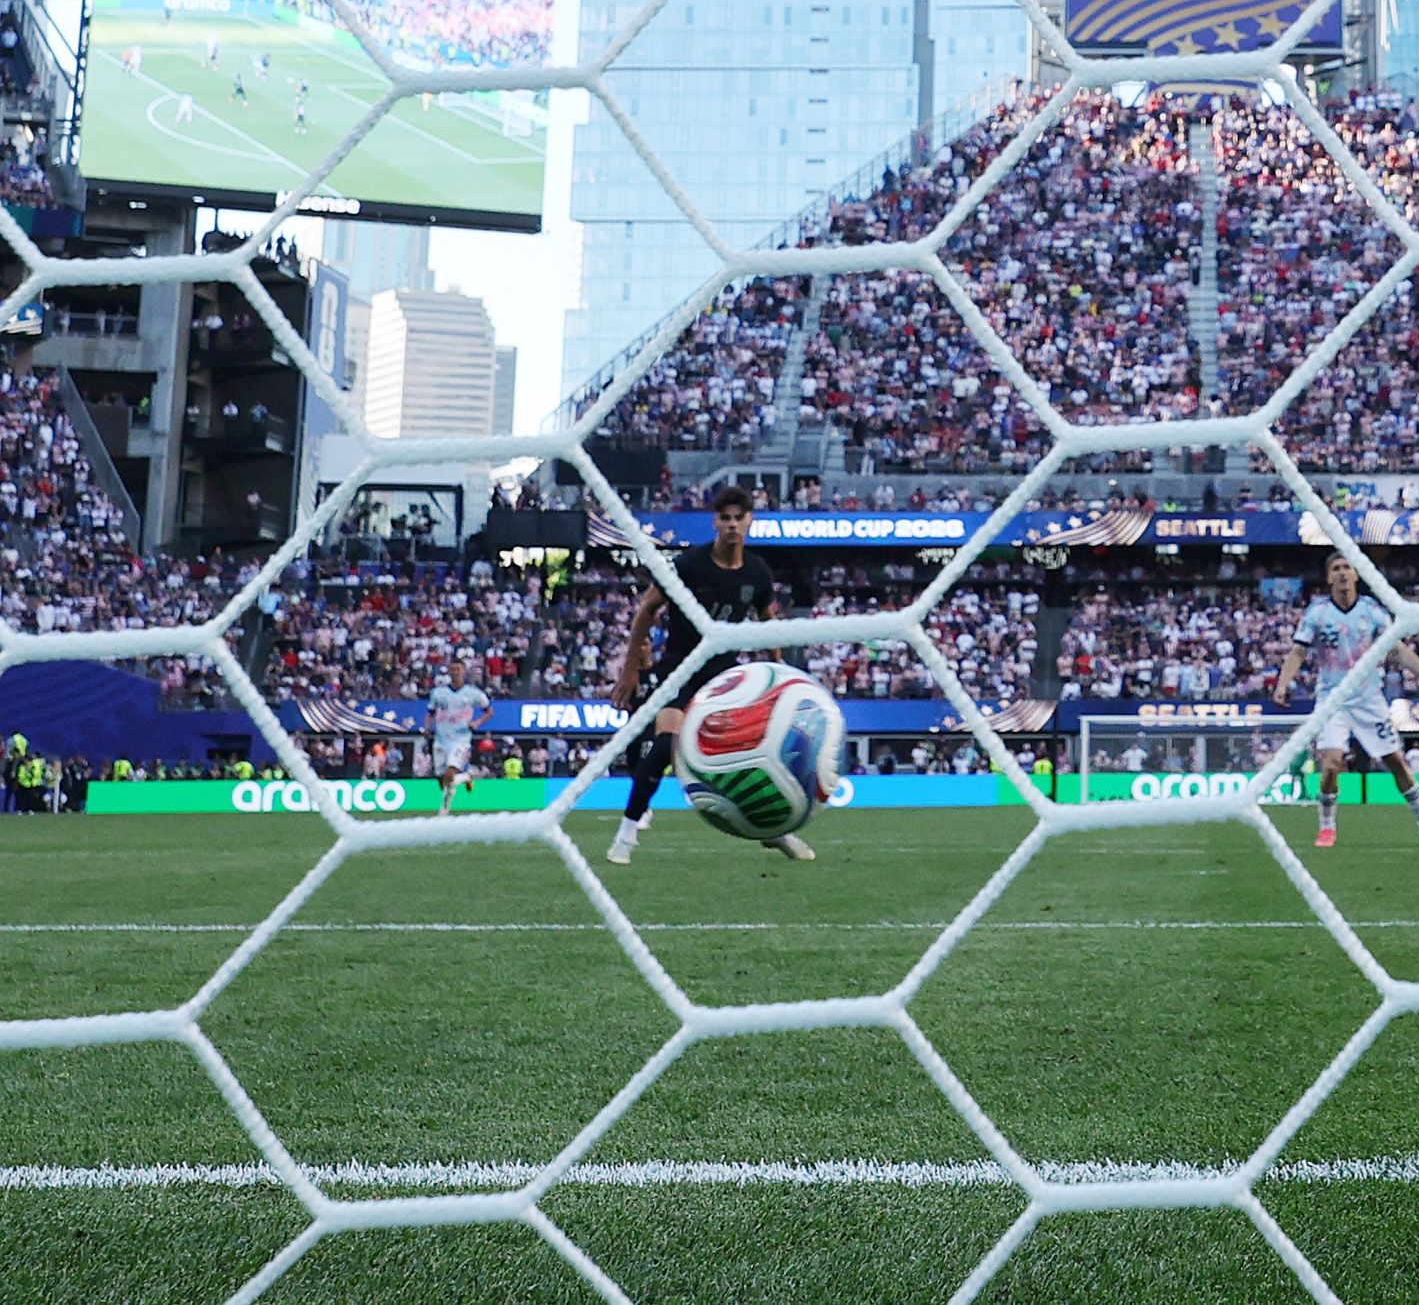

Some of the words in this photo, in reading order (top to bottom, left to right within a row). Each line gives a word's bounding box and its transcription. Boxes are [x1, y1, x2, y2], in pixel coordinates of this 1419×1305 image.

[749, 519, 782, 539] IFA
[780, 519, 854, 539] WORLD
[853, 519, 895, 539] CUP
[894, 519, 965, 539] 2026
[1155, 519, 1247, 537] SEATTLE
[520, 703, 582, 729] FIFA
[1138, 703, 1264, 727] SEATTLE
